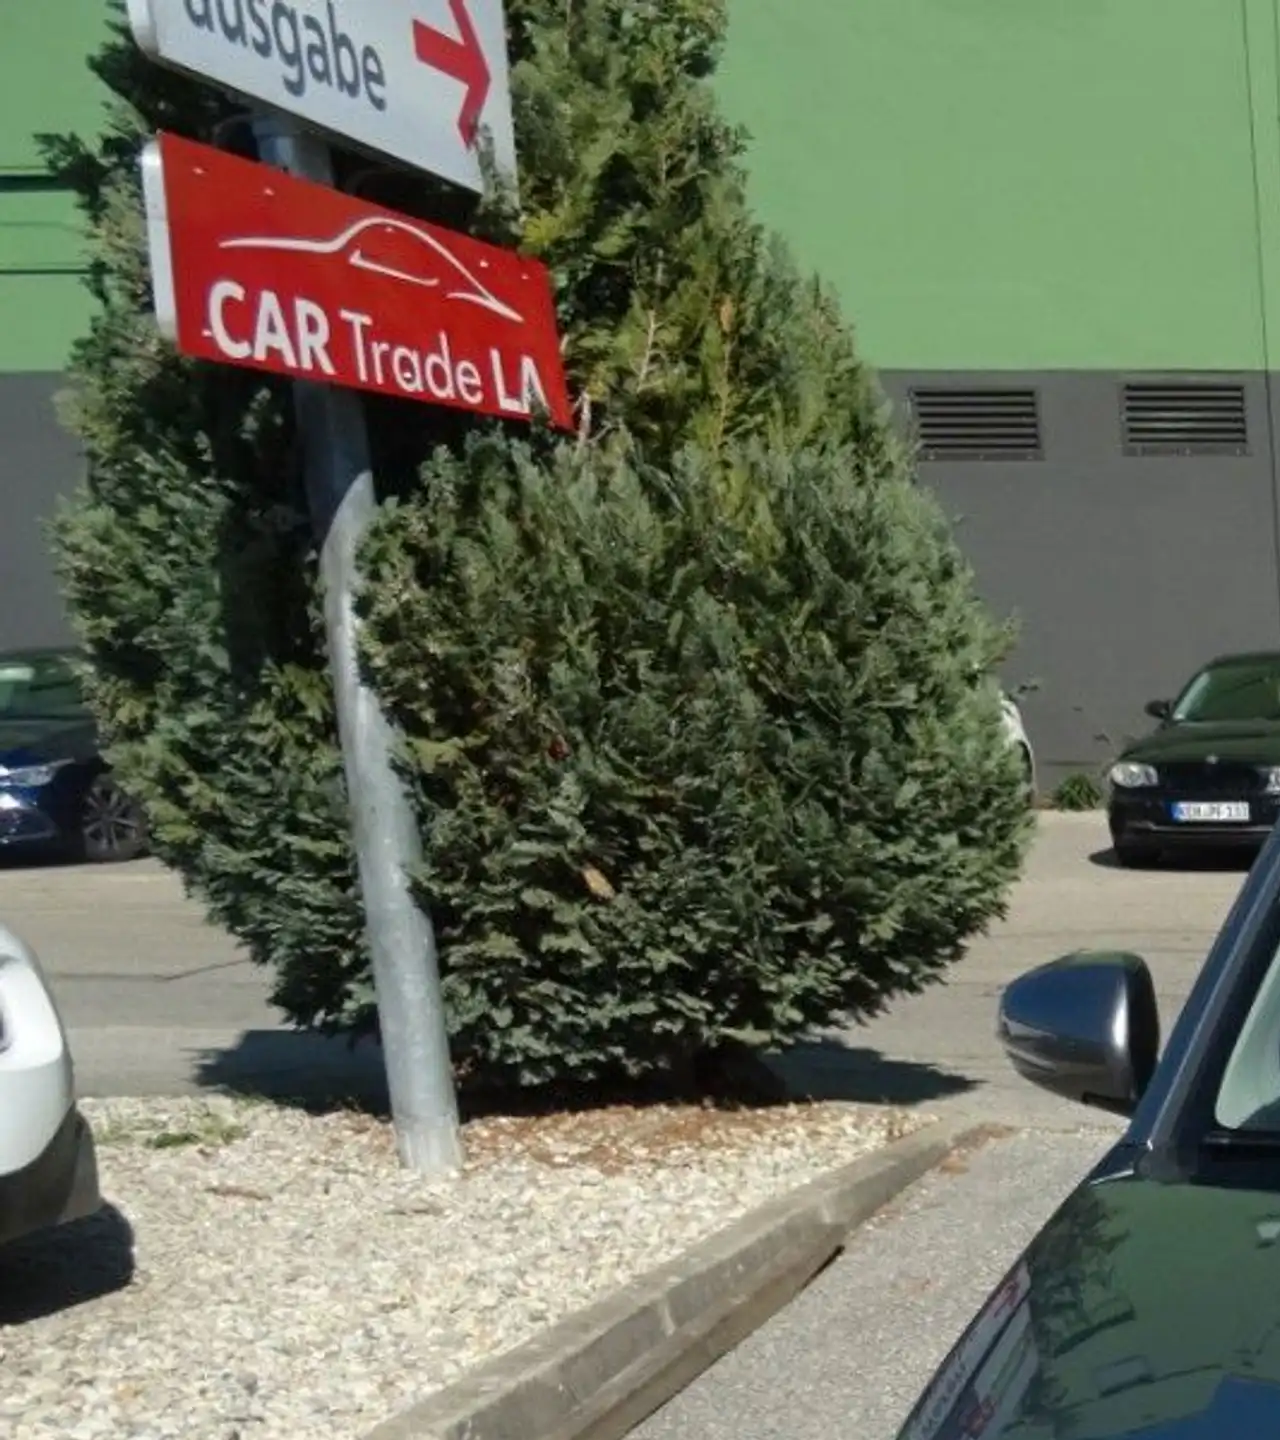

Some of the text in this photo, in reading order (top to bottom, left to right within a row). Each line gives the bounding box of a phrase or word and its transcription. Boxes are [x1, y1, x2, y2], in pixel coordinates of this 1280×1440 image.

[207, 280, 552, 416] CAR Trade LA
